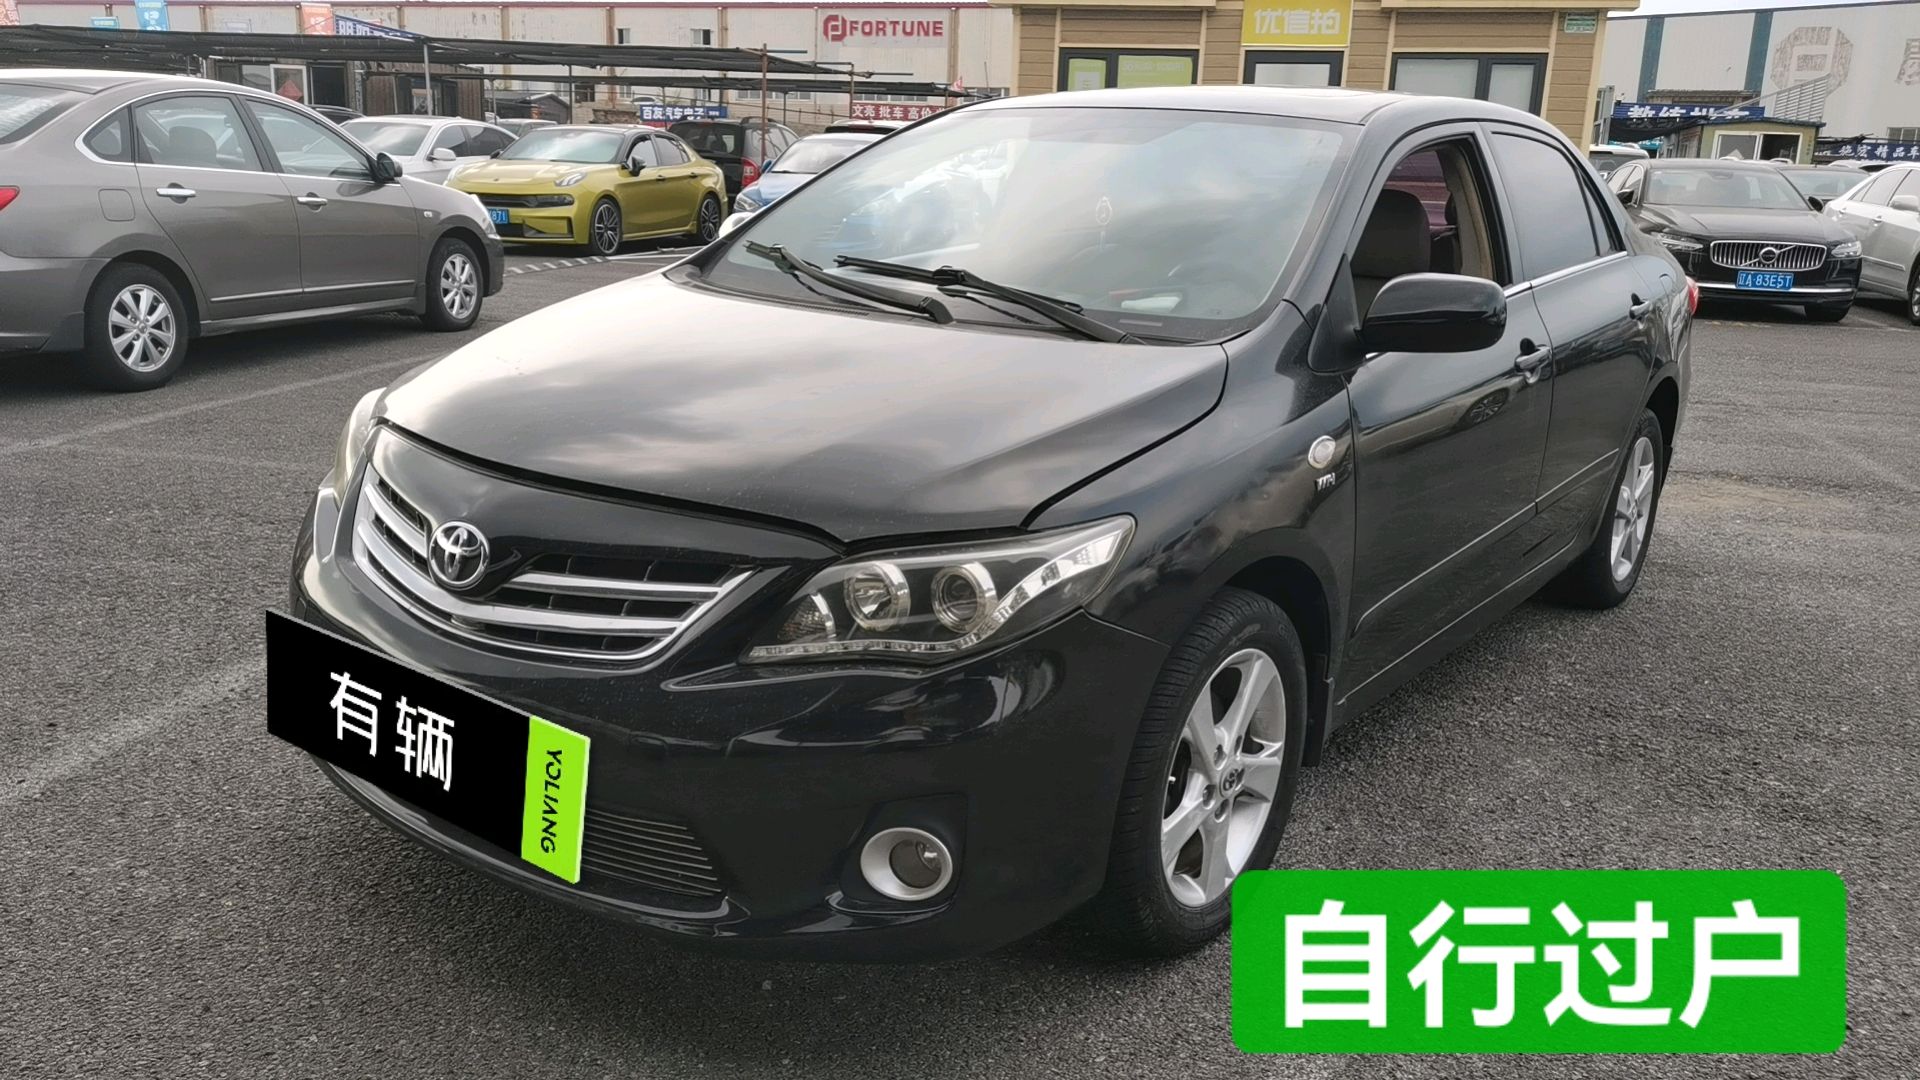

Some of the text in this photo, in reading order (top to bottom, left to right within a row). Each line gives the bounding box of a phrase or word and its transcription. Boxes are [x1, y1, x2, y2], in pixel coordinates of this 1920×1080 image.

[849, 20, 943, 37] FORTUNE
[1254, 8, 1341, 35] 优信拍
[852, 104, 946, 120] 文亮批车高价
